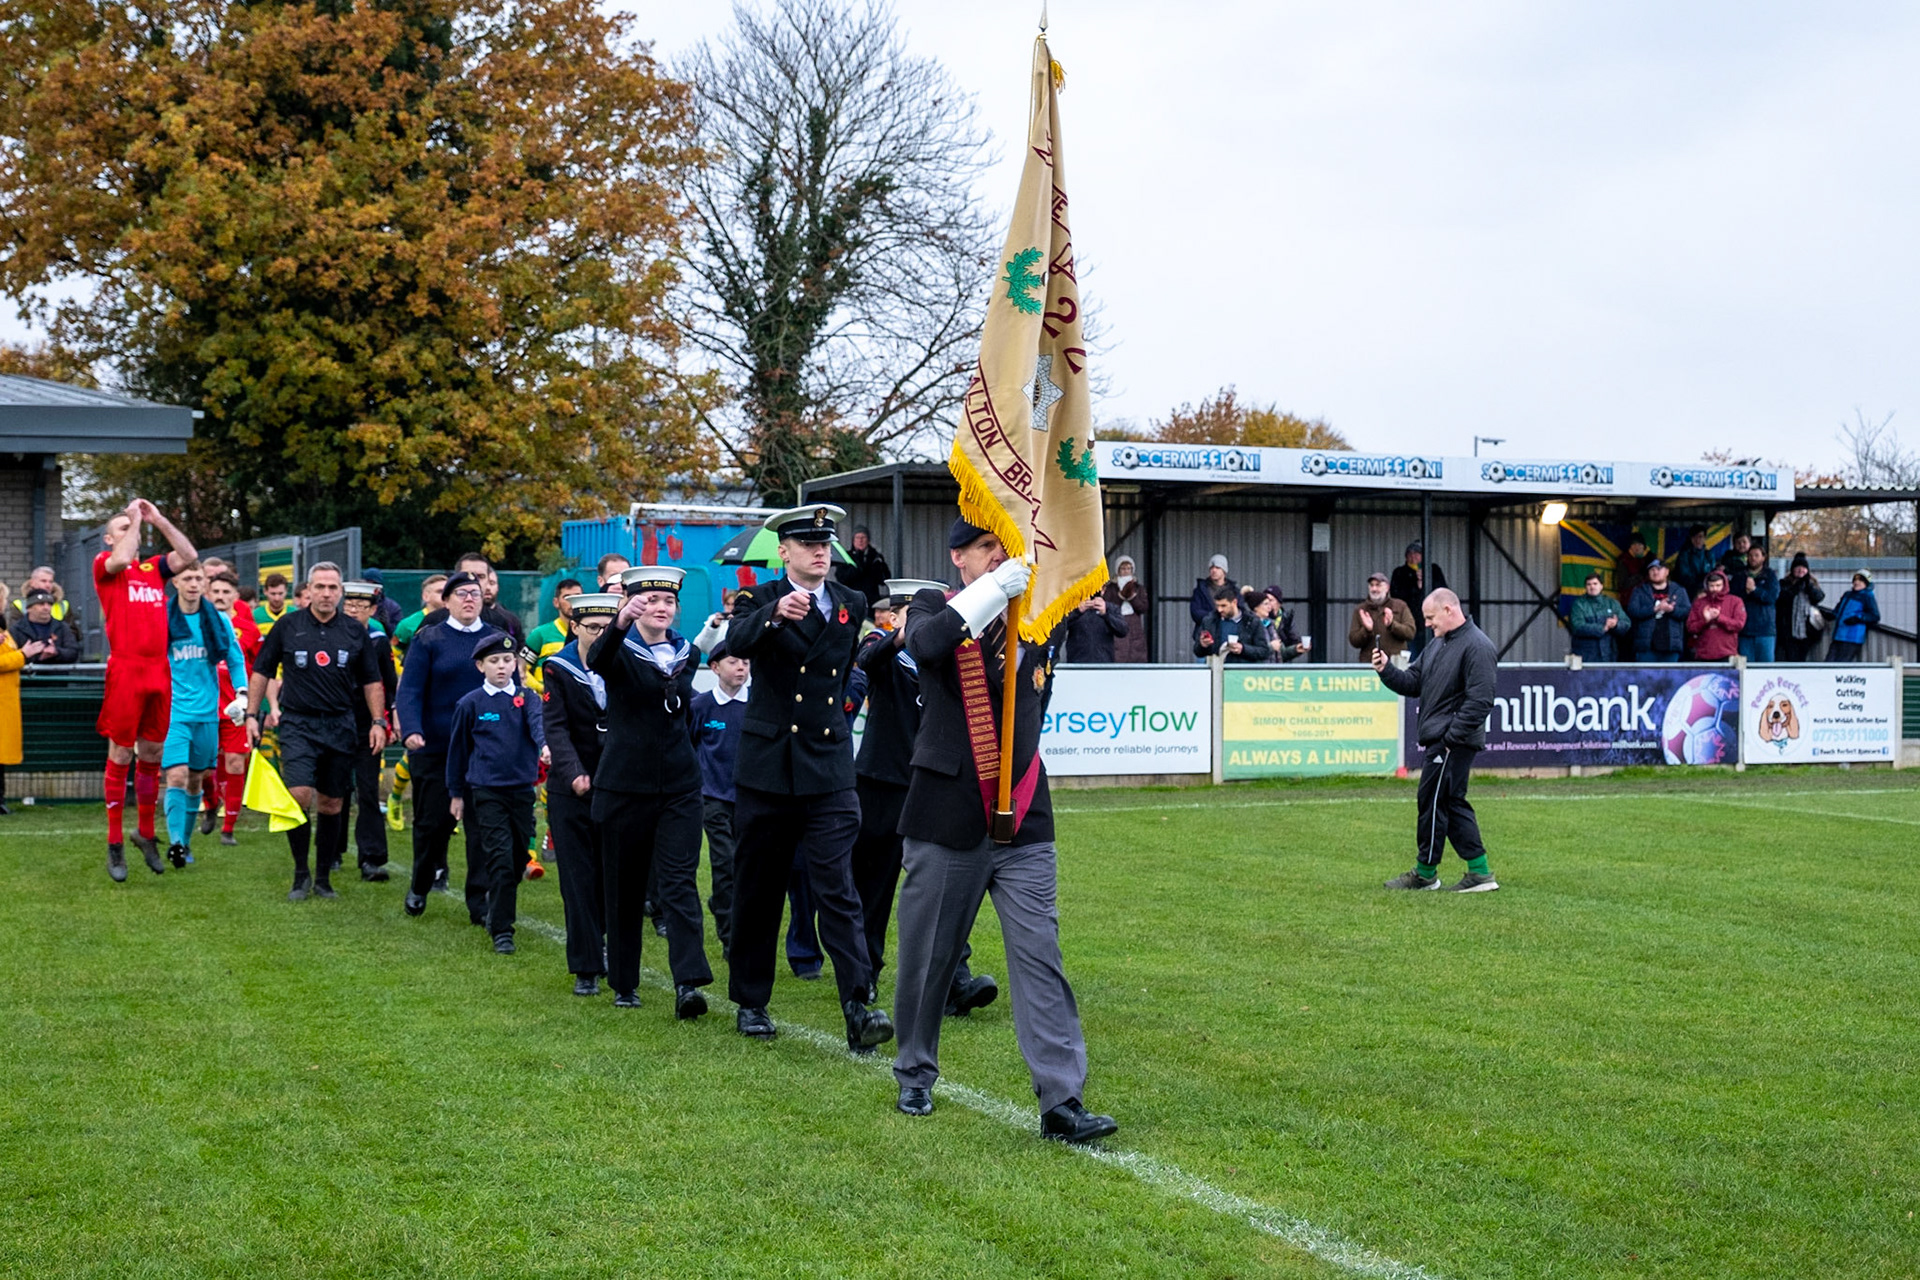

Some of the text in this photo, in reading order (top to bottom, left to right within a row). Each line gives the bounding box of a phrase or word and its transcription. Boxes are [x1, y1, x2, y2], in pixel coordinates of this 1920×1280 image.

[967, 375, 1002, 450] ALTON
[172, 645, 209, 661] Miln
[1243, 676, 1382, 692] ONCE A LINNET
[1835, 675, 1867, 686] Walking
[1750, 676, 1809, 709] Pooch Perfect
[1836, 688, 1866, 699] Cutting
[1838, 702, 1864, 712] Caring
[1040, 705, 1198, 739] erseyflow
[1252, 716, 1374, 726] SIMON CHARLESWORTH
[1045, 744, 1199, 756] easier, more reliable journeys
[1493, 741, 1506, 751] and
[1507, 741, 1537, 751] Resource
[1537, 741, 1581, 752] Management
[1582, 740, 1611, 749] Solutions
[1612, 739, 1657, 749] millbank.com
[1229, 749, 1389, 766] ALWAYS A LINNET
